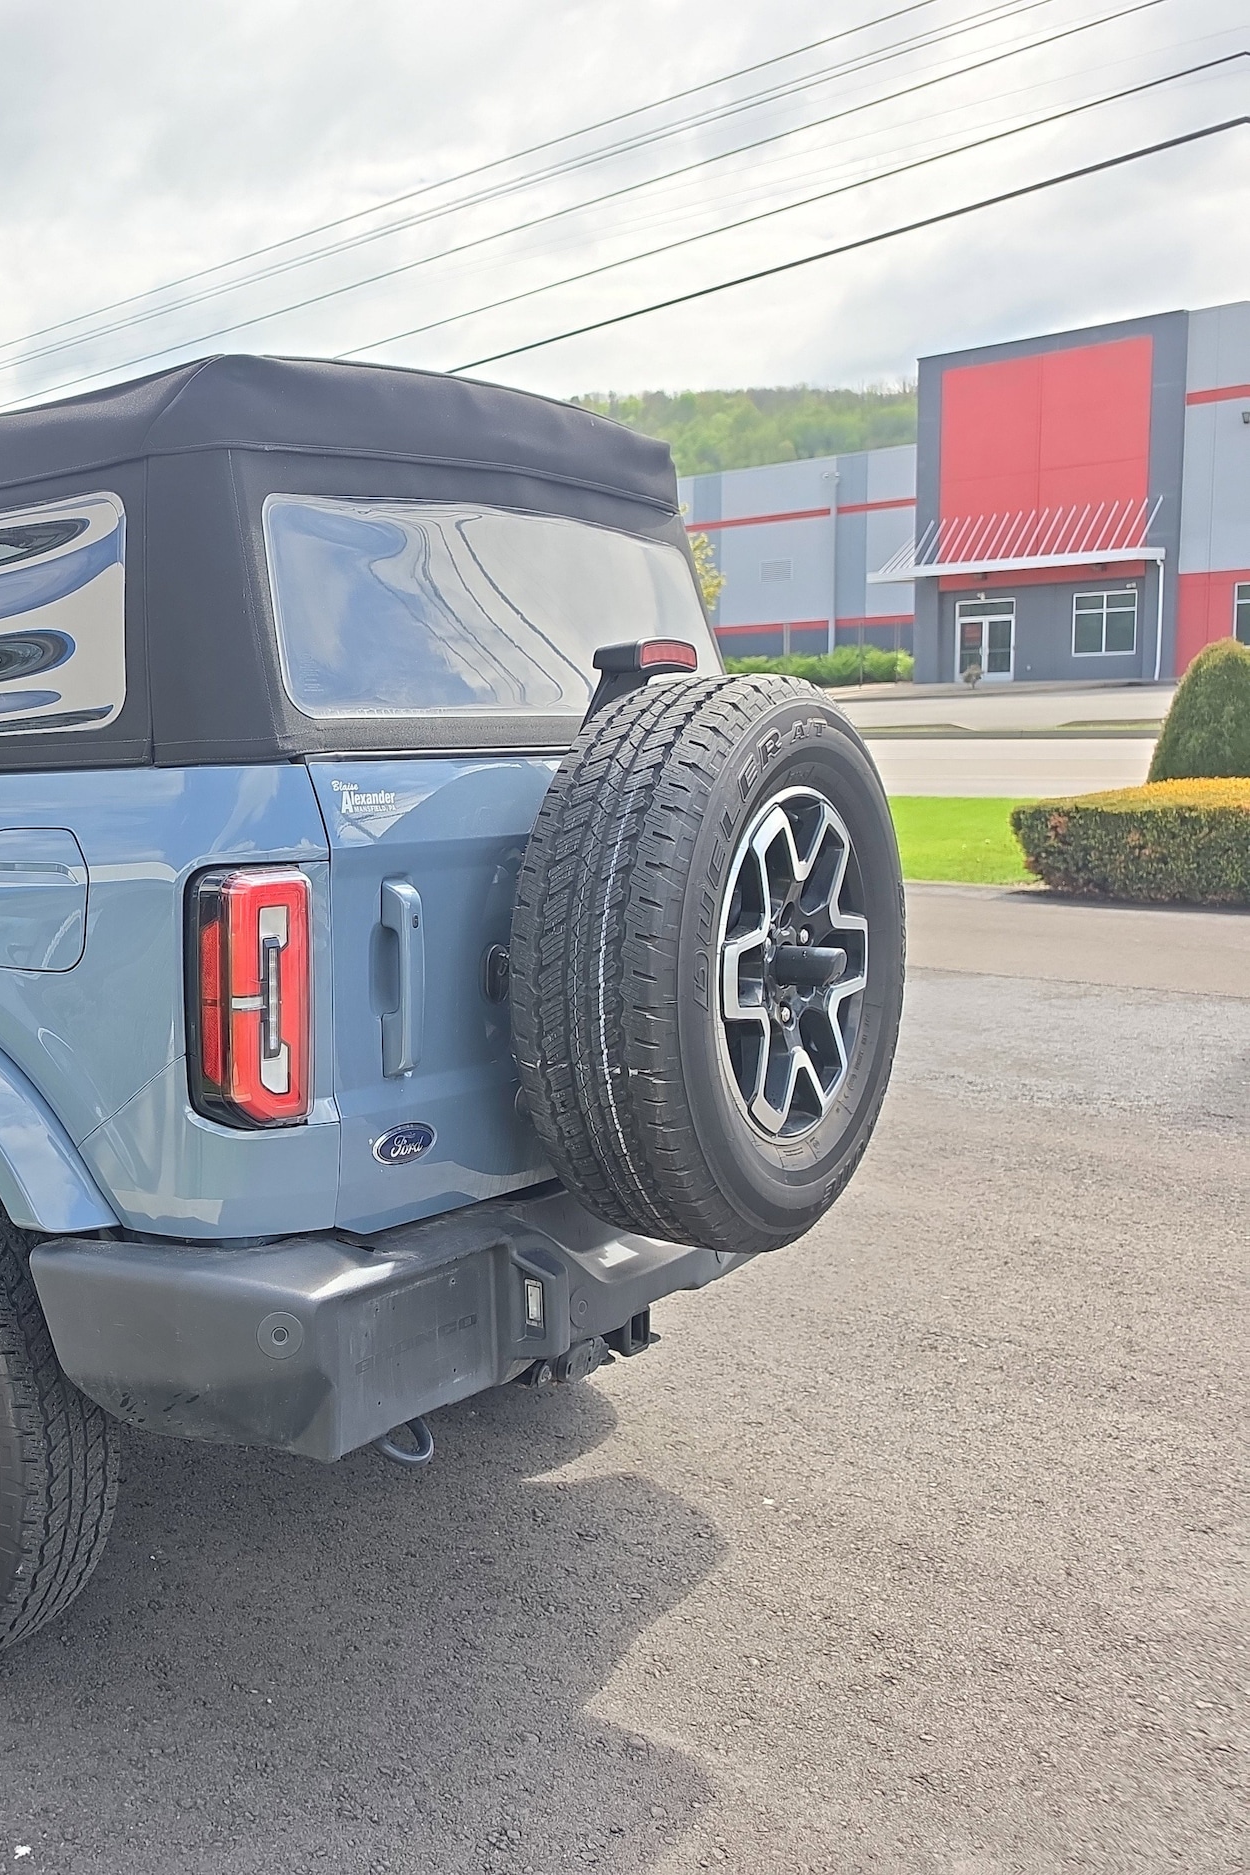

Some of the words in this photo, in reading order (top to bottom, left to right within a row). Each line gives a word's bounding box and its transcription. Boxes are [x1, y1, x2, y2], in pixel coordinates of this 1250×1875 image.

[331, 779, 359, 792] Blaise
[341, 790, 396, 814] Alexander
[693, 726, 783, 1012] DUELER
[789, 718, 829, 746] A/T
[390, 1132, 424, 1158] Ford
